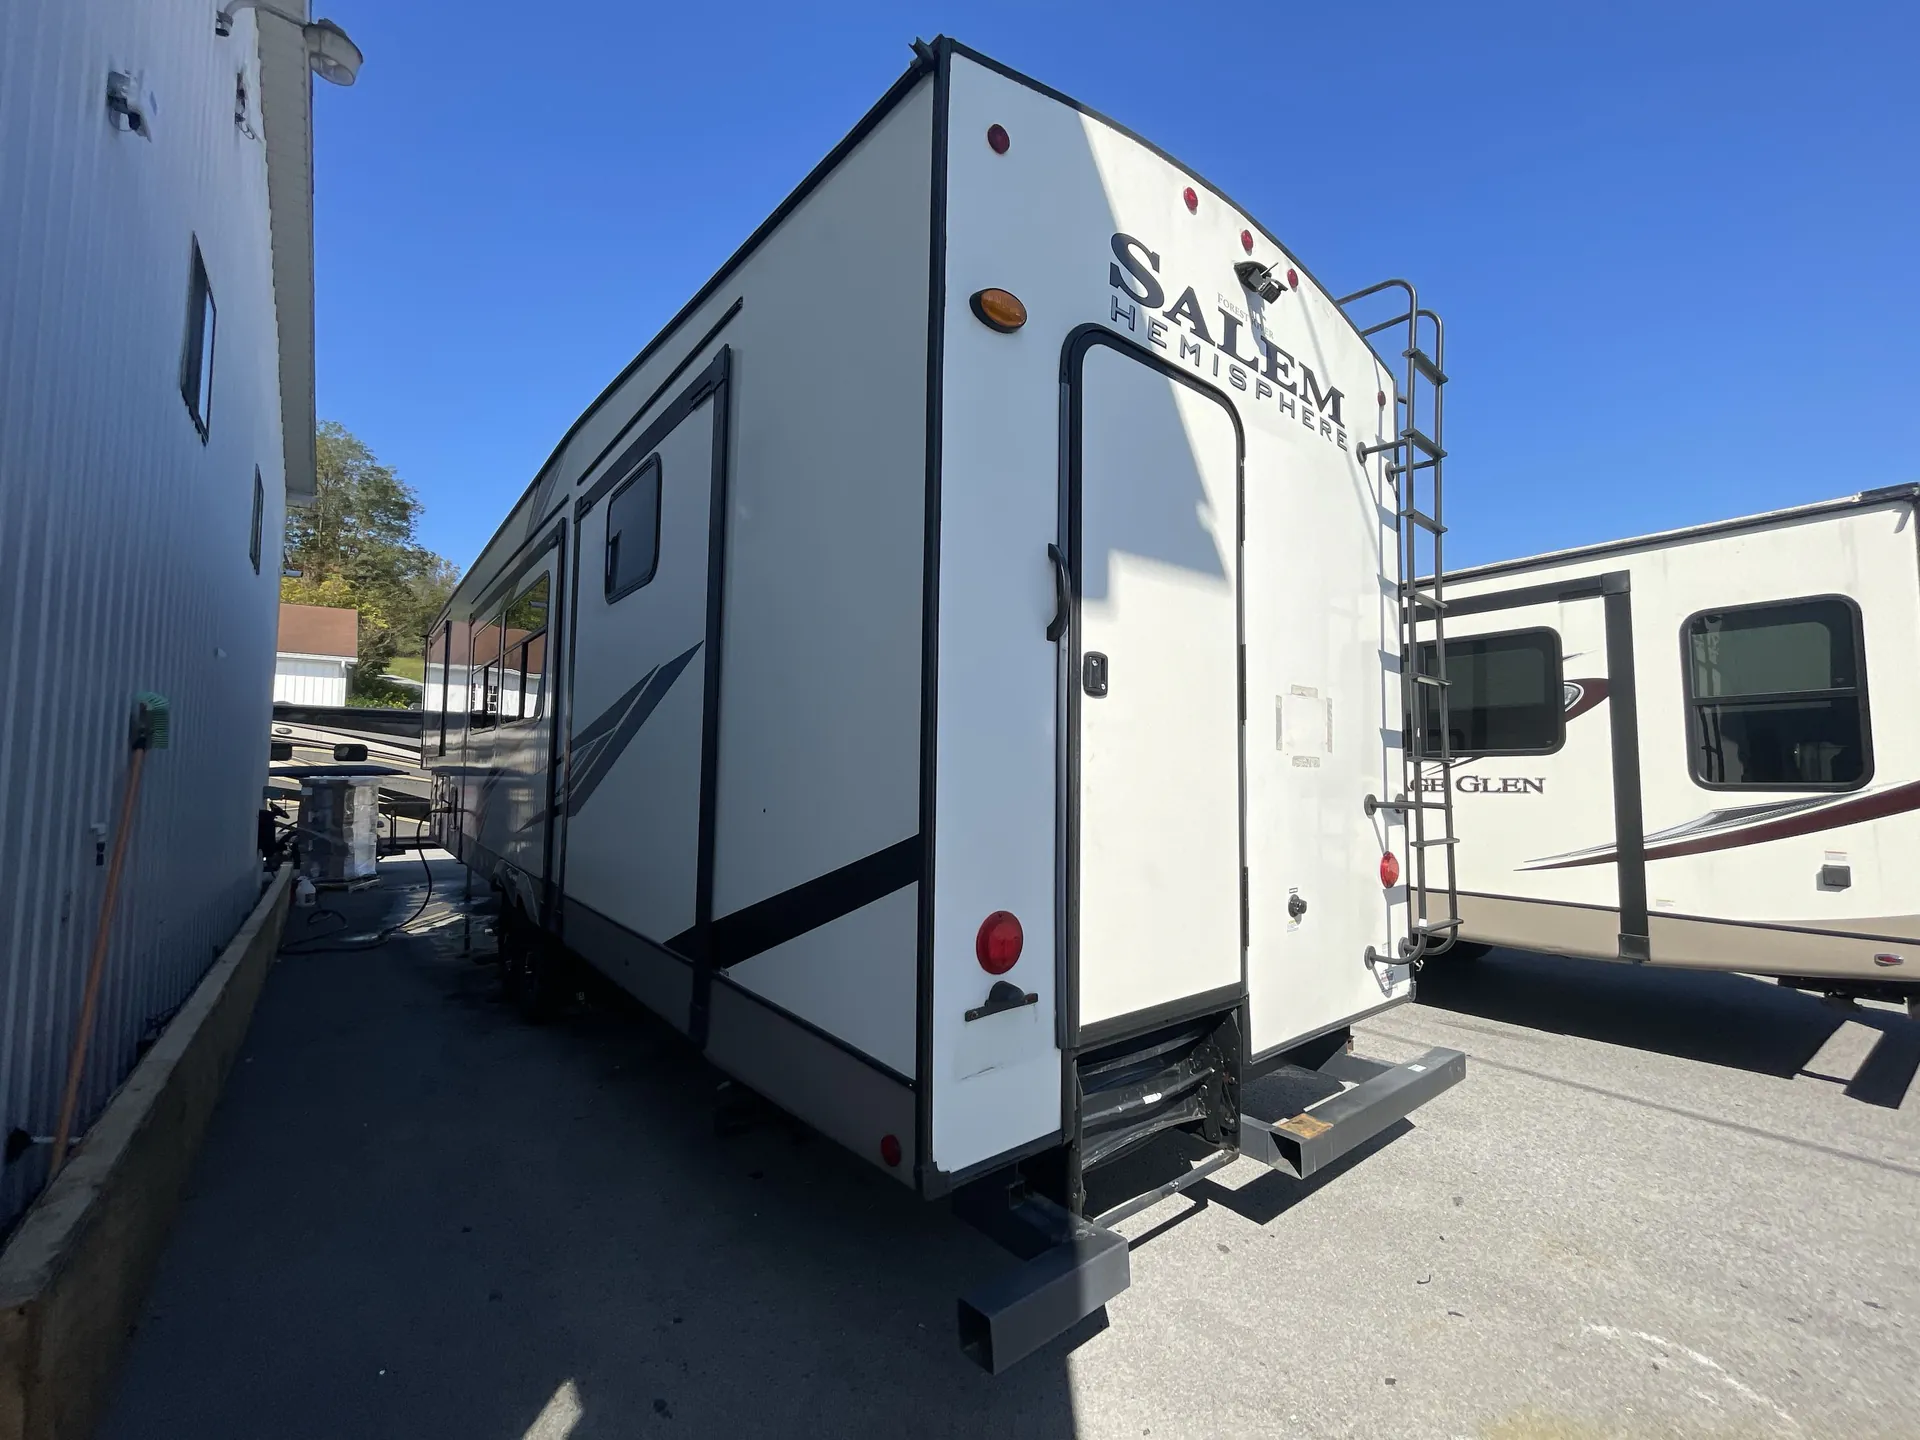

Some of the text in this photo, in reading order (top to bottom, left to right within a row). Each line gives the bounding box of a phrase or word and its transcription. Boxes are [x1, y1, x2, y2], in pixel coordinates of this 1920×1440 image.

[1110, 232, 1345, 428] SALEM
[1217, 292, 1249, 322] FOREST
[1111, 295, 1347, 451] HEMISPHERE
[1456, 775, 1546, 794] GLEN
